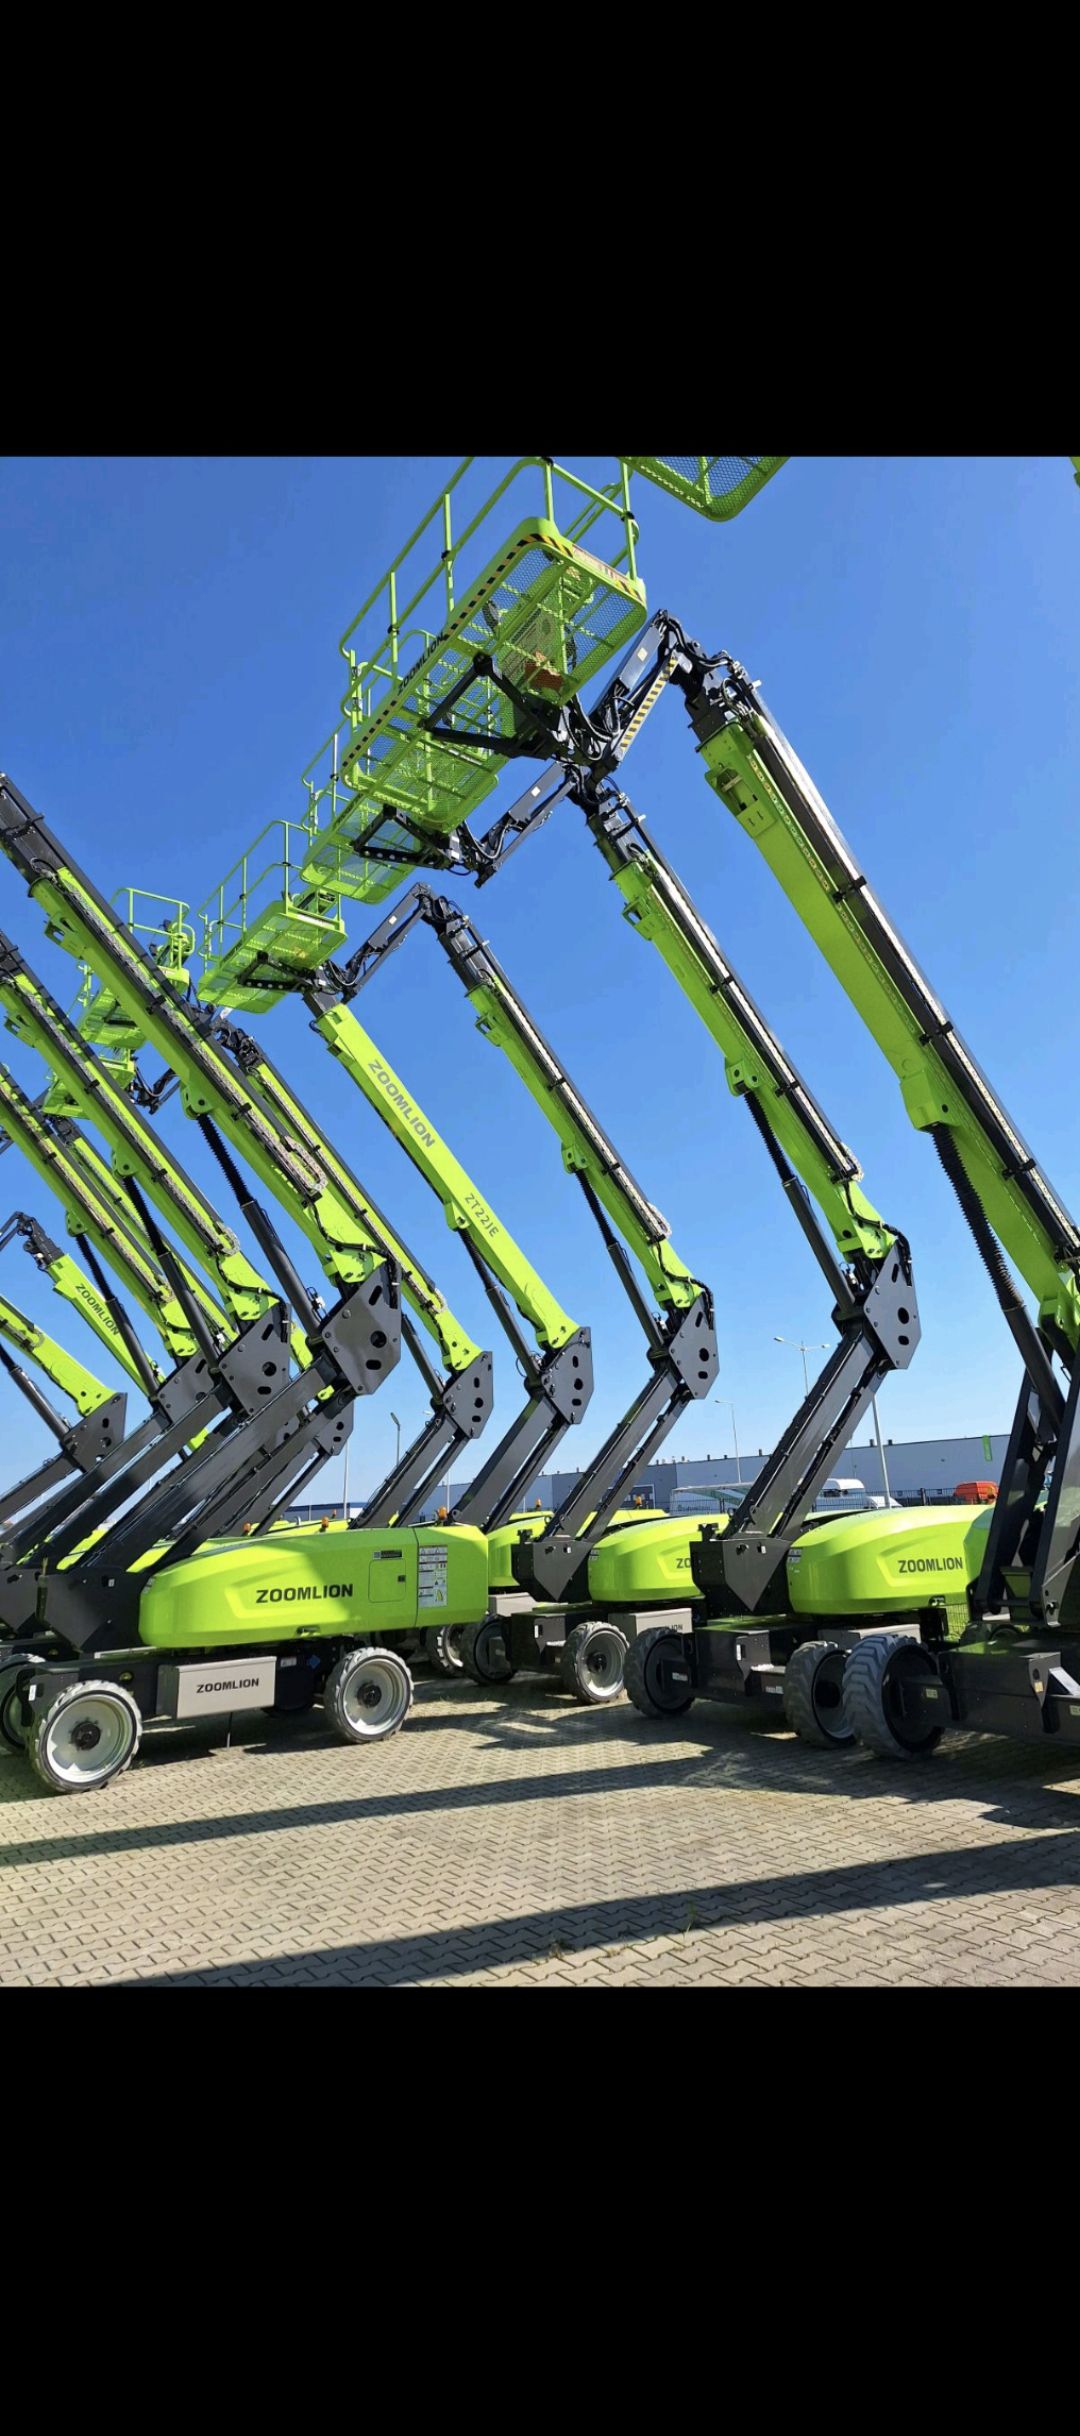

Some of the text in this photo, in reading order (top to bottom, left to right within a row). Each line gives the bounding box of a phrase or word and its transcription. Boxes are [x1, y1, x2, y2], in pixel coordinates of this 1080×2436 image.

[368, 1059, 435, 1148] ZOOMLION
[75, 1283, 119, 1336] ZOOMLION
[897, 1557, 963, 1573] ZOOMLION
[256, 1584, 353, 1604] ZOOMLION
[196, 1678, 260, 1694] ZOOMLION
